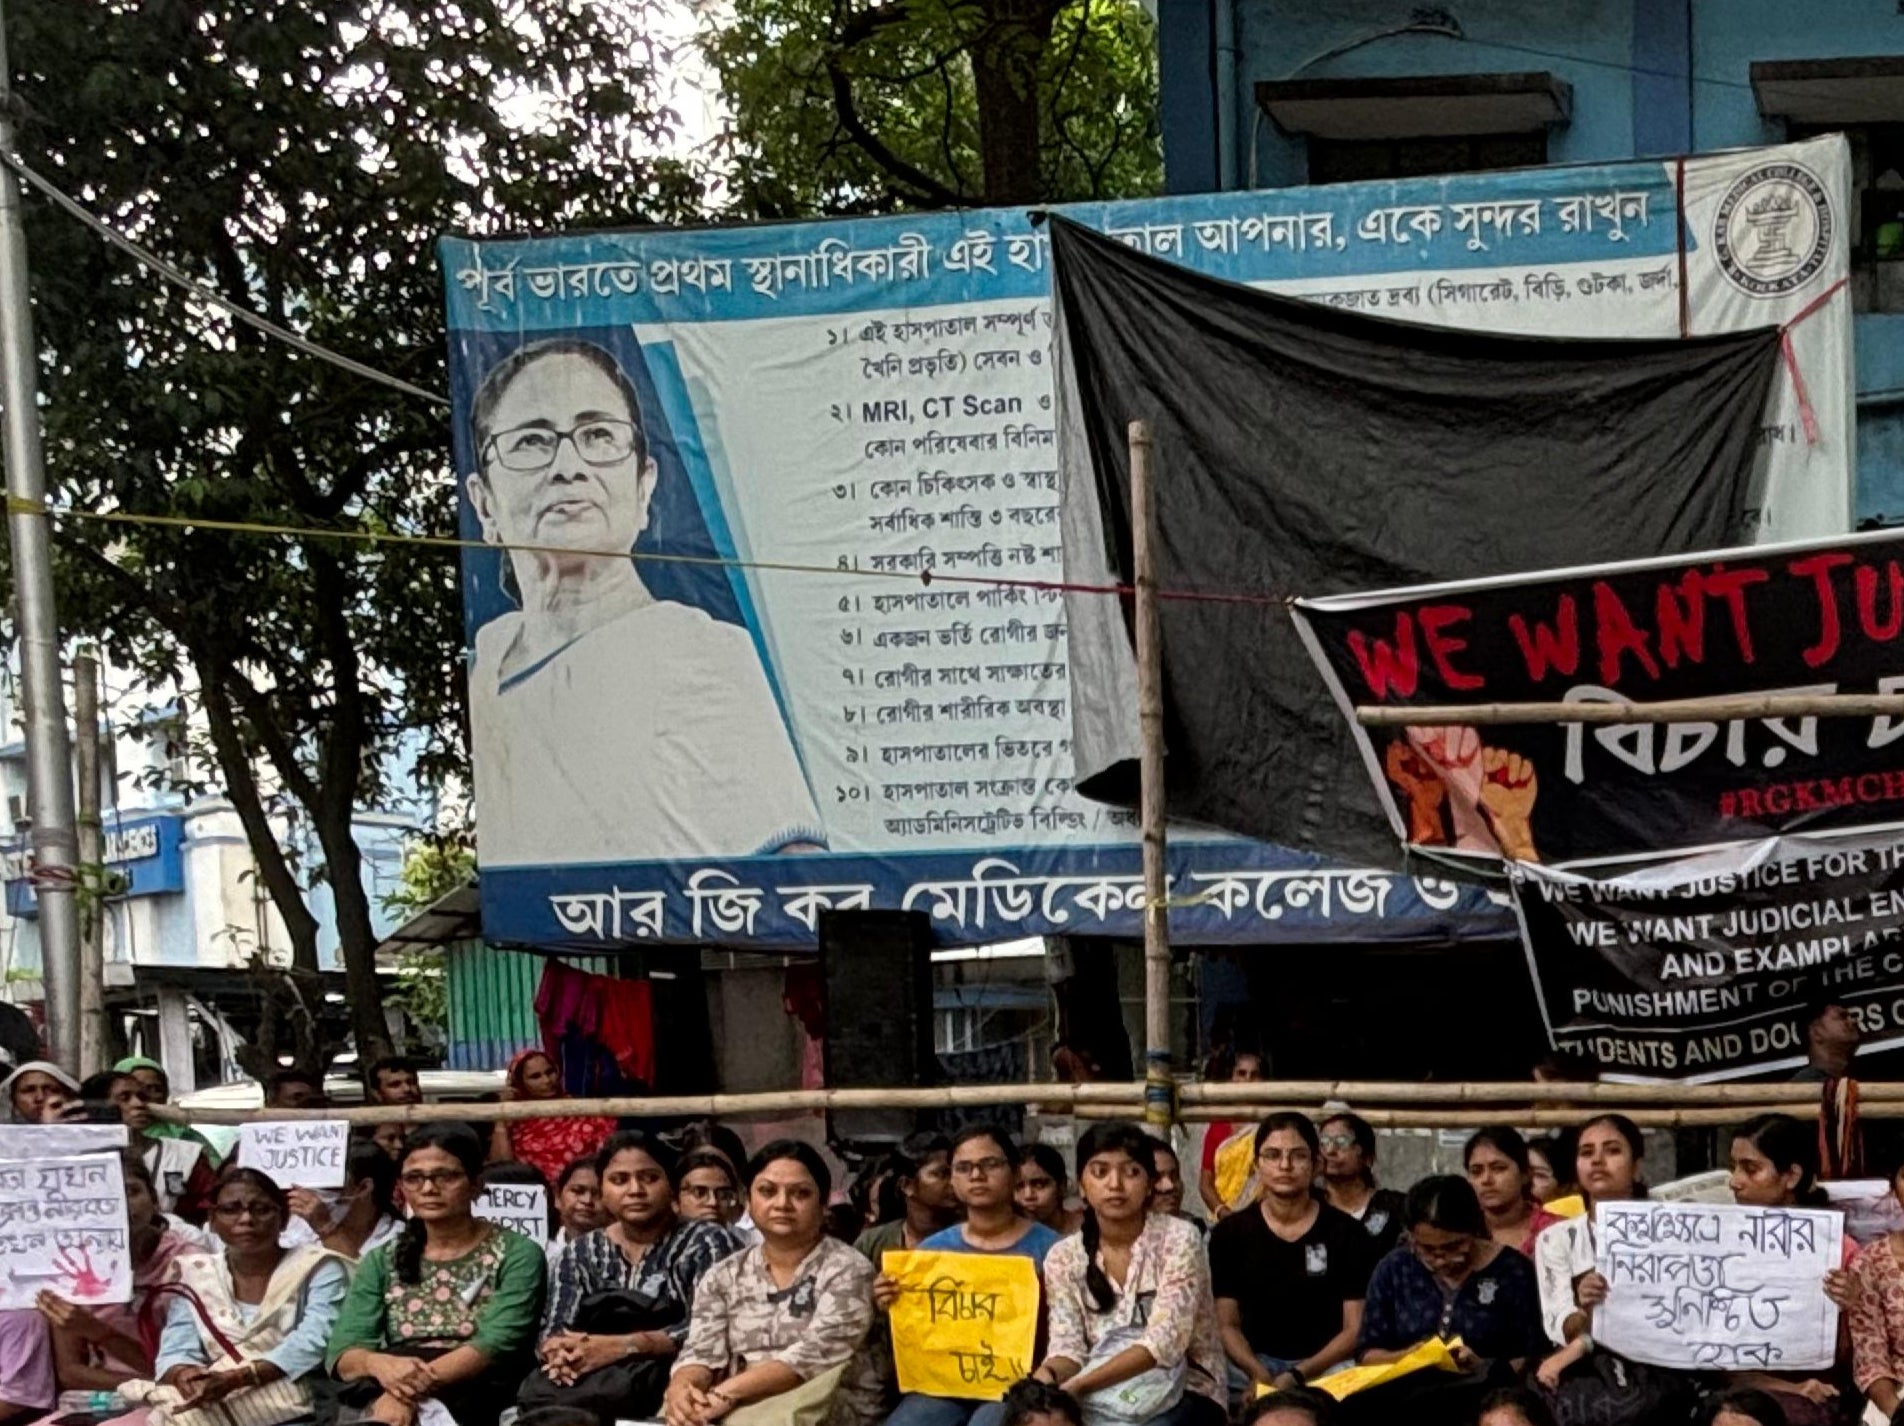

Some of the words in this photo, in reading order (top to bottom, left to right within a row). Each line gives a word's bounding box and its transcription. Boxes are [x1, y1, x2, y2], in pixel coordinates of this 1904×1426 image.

[526, 261, 641, 298] ভারতে
[650, 257, 732, 297] প্রথম
[740, 235, 930, 298] স্থানাধিকারী
[943, 234, 996, 274] এই
[1195, 206, 1346, 256] আপনার,
[1359, 202, 1443, 244] একে
[1453, 196, 1542, 254] সুন্দর
[1555, 186, 1650, 243] রাখুন
[862, 402, 915, 425] MRI,
[922, 398, 956, 420] CT
[962, 394, 1023, 417] Scan
[1347, 602, 1486, 702] WE
[1508, 559, 1772, 686] WANT
[1805, 850, 1864, 883] FOR
[548, 883, 666, 940] আর
[684, 867, 763, 938] জি
[1193, 866, 1394, 922] কলেজ
[1566, 919, 1619, 949] WE
[1626, 911, 1717, 944] WANT
[1721, 894, 1866, 941] JUDICIAL
[1660, 948, 1726, 983] AND
[1572, 980, 1763, 1018] PUNISHMENT
[1819, 955, 1877, 988] THE
[1683, 1030, 1744, 1065] AND
[254, 1126, 285, 1145] WE
[263, 1144, 341, 1170] JUSTICE
